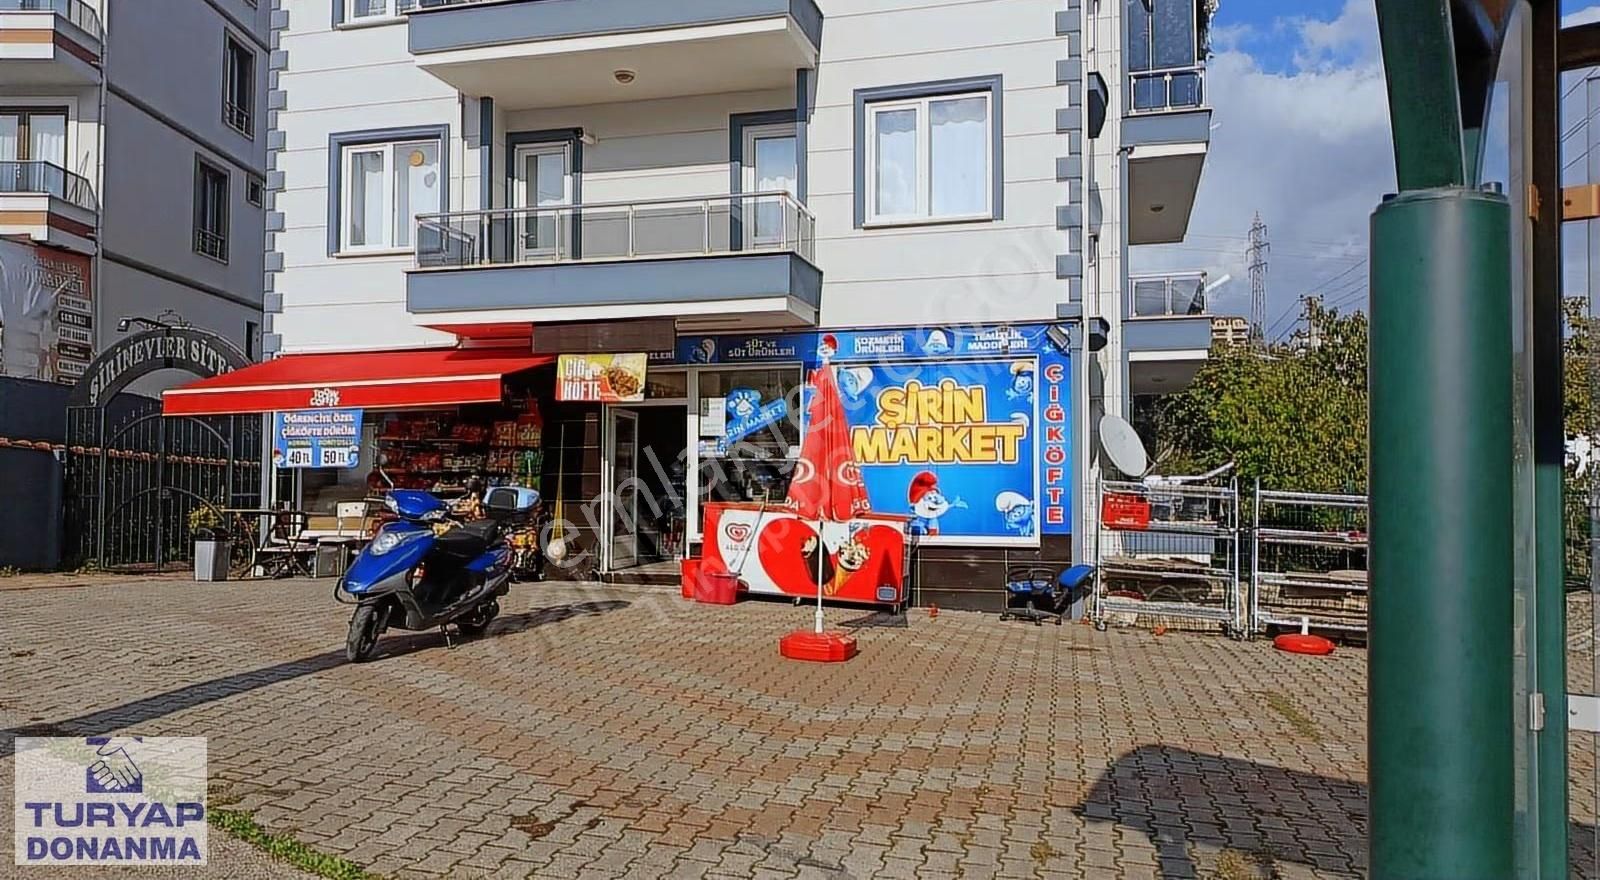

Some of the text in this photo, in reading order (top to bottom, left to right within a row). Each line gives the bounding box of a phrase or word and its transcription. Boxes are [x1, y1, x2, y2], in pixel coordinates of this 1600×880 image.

[878, 380, 985, 429] ŞİRİN
[289, 450, 301, 464] 40
[324, 450, 337, 464] 50
[851, 424, 1025, 464] MARKET
[1044, 364, 1066, 524] ÇİĞKÖFTE
